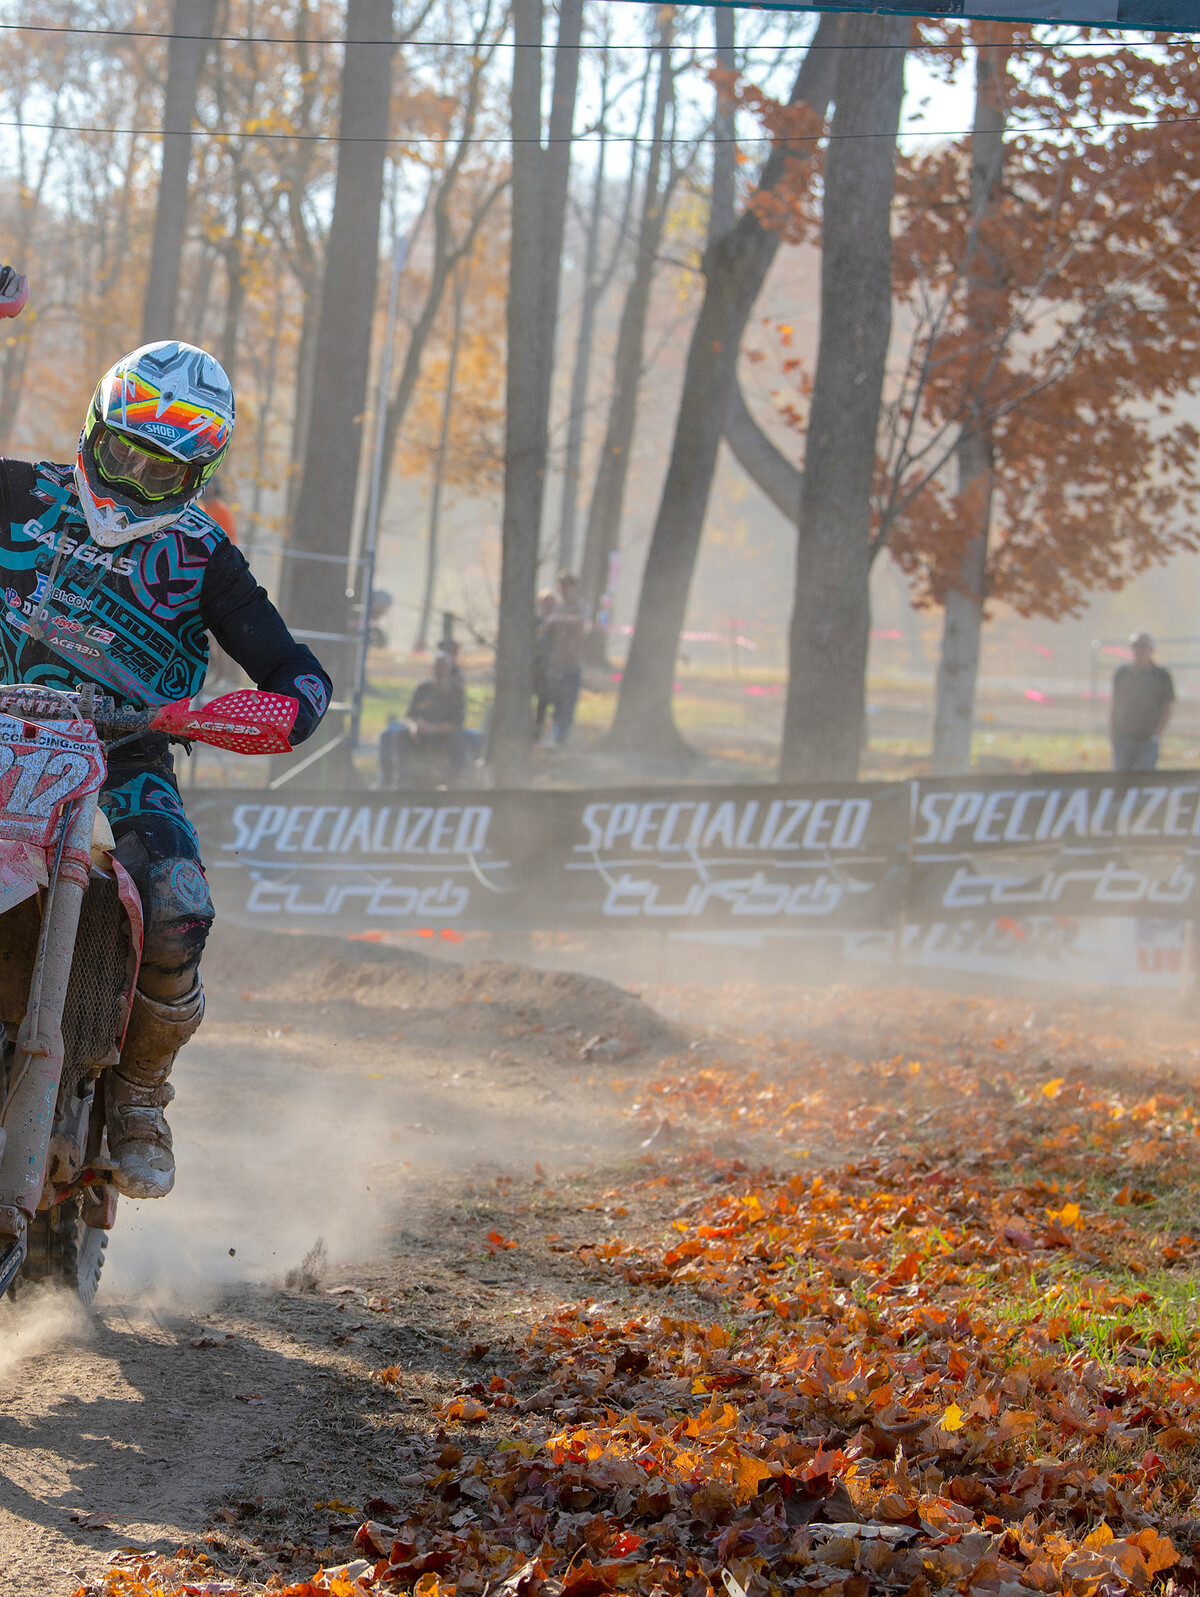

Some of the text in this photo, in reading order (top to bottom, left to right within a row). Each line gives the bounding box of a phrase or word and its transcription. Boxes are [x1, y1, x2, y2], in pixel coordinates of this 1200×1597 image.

[147, 424, 176, 438] SHOEI
[67, 506, 86, 518] MOTO
[22, 518, 137, 576] GASGAS
[54, 617, 81, 632] IMS
[105, 647, 153, 684] RACING
[221, 804, 493, 854] SPECIALIZED
[573, 799, 871, 851] SPECIALIZED
